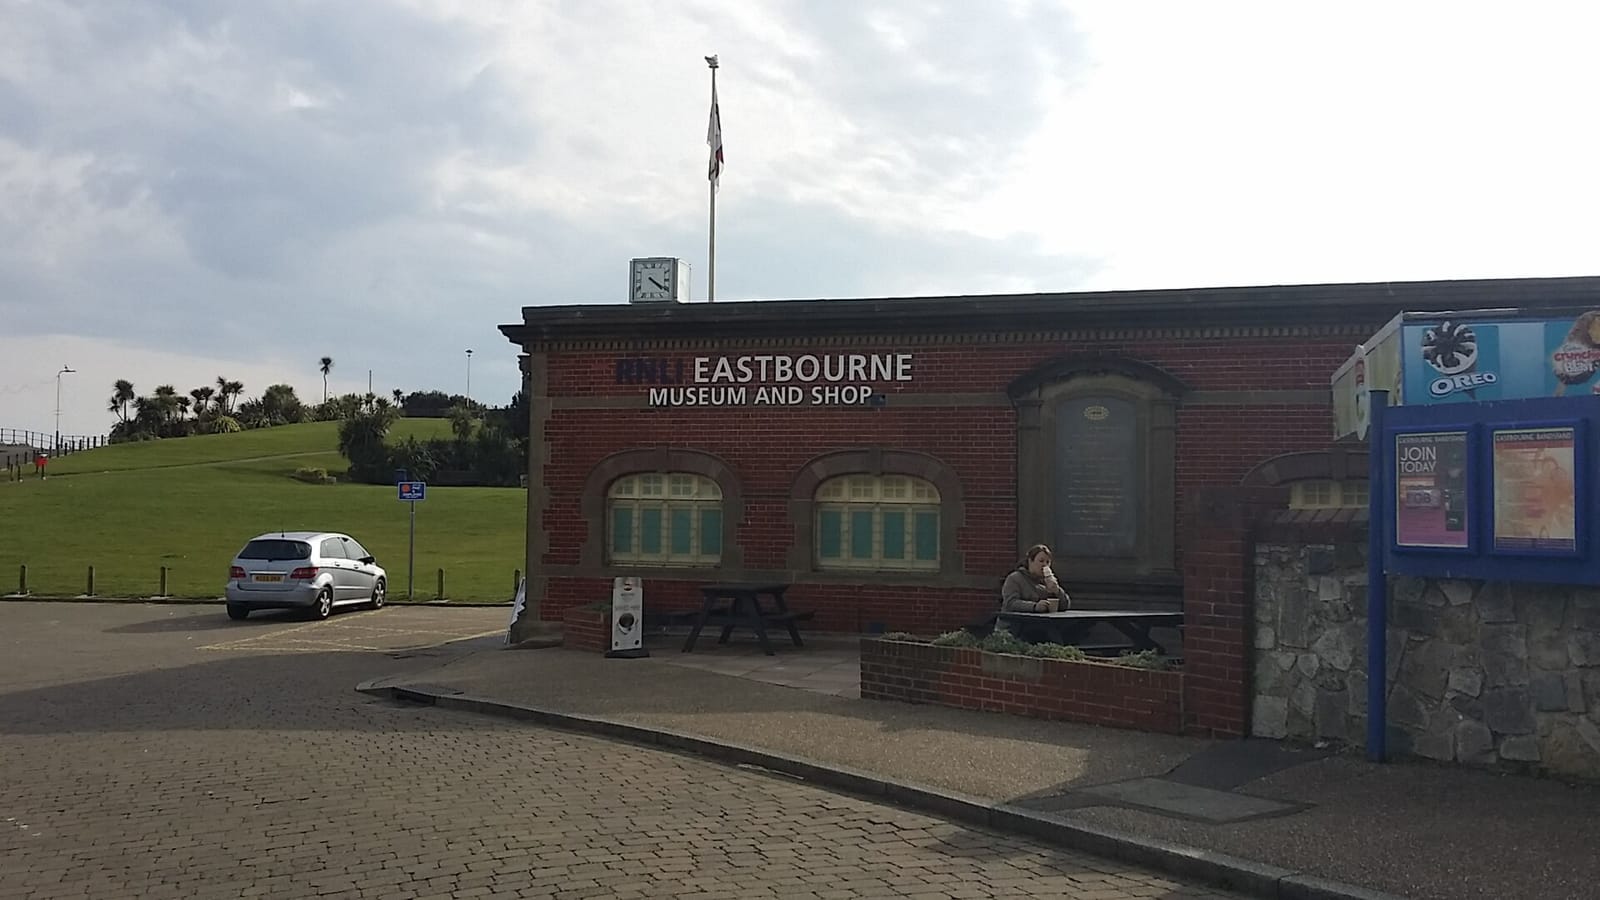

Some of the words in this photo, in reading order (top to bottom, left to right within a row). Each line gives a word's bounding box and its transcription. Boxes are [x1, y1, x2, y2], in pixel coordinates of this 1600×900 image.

[693, 353, 914, 383] EASTBOURNE
[1430, 372, 1497, 396] OREO
[648, 387, 747, 407] MUSEUM
[754, 386, 803, 405] AND
[811, 385, 873, 405] SHOP
[1400, 446, 1437, 461] JOIN
[1400, 460, 1437, 473] TODAY
